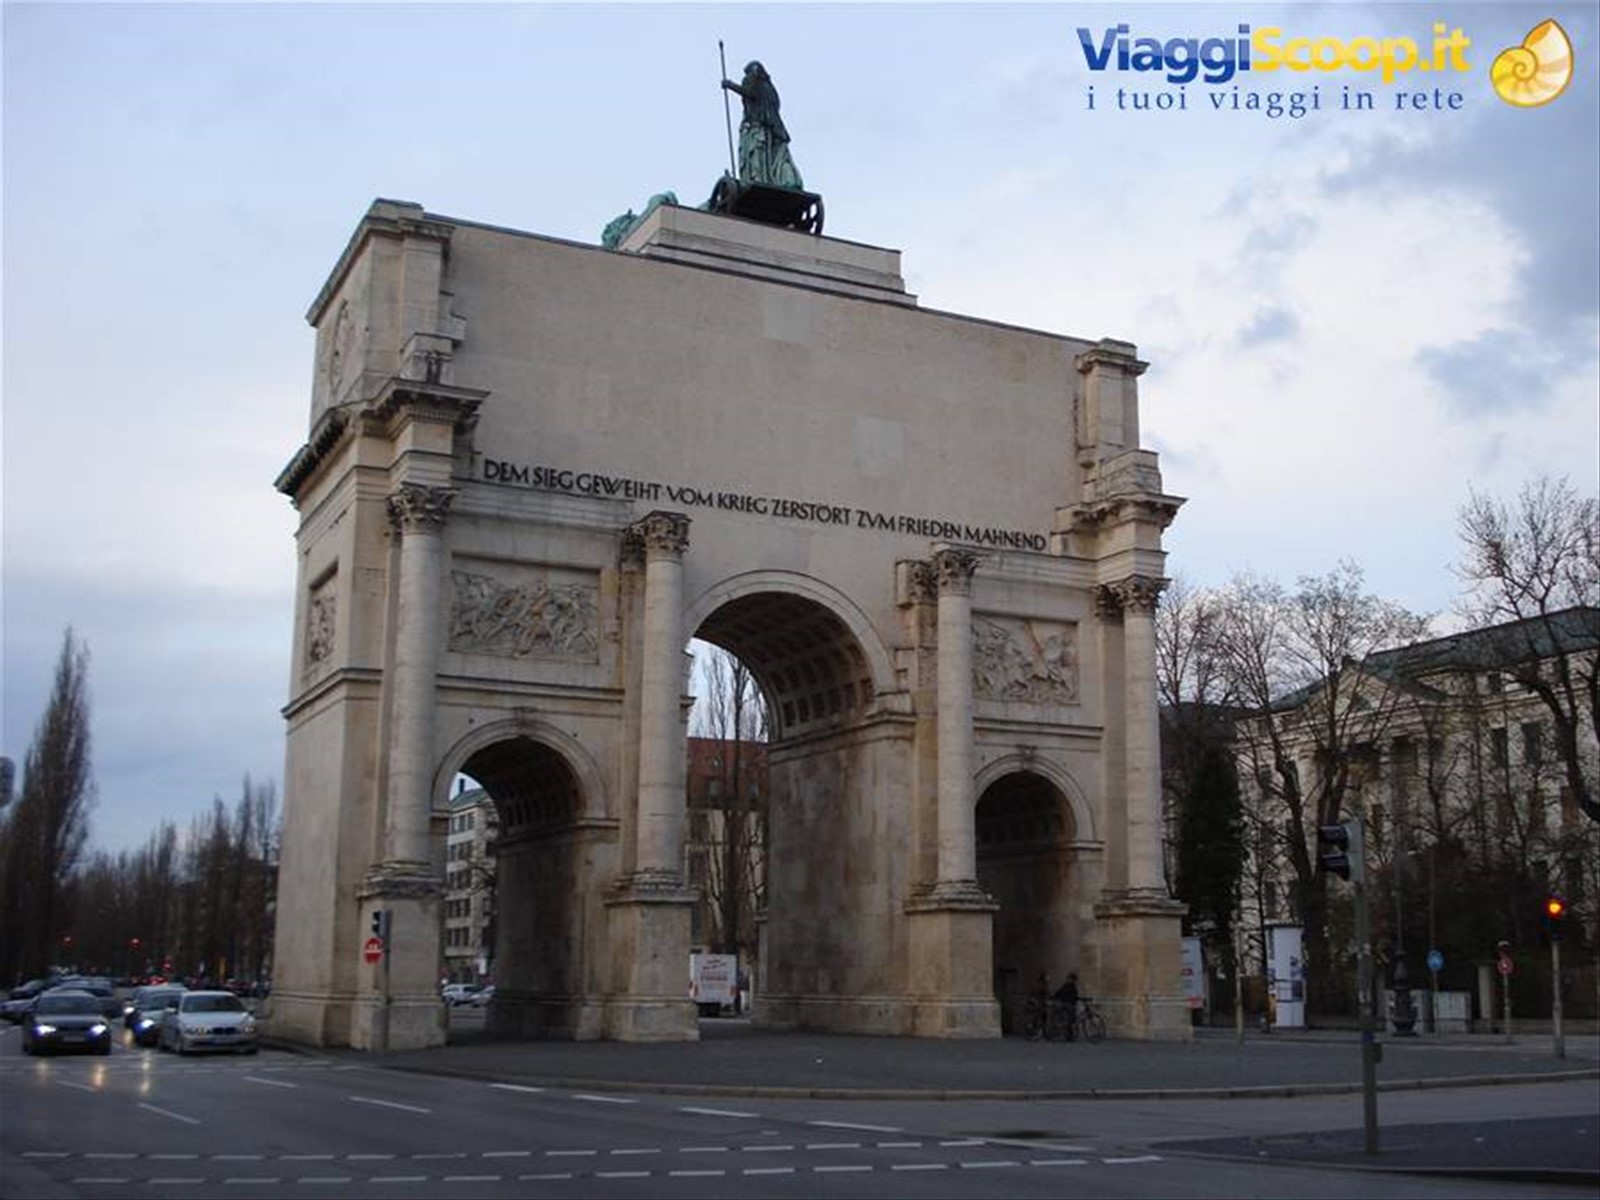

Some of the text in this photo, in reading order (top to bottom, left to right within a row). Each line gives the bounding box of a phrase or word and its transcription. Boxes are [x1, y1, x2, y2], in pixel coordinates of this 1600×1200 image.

[484, 459, 529, 484] DEM
[533, 466, 574, 490] SIEG
[576, 473, 662, 501] GEWEIHT
[666, 485, 714, 508] VOM
[717, 492, 769, 515] KRIEG
[855, 509, 896, 532] ZVM
[898, 515, 962, 540] FRIEDEN
[964, 524, 1047, 551] MAHNEND
